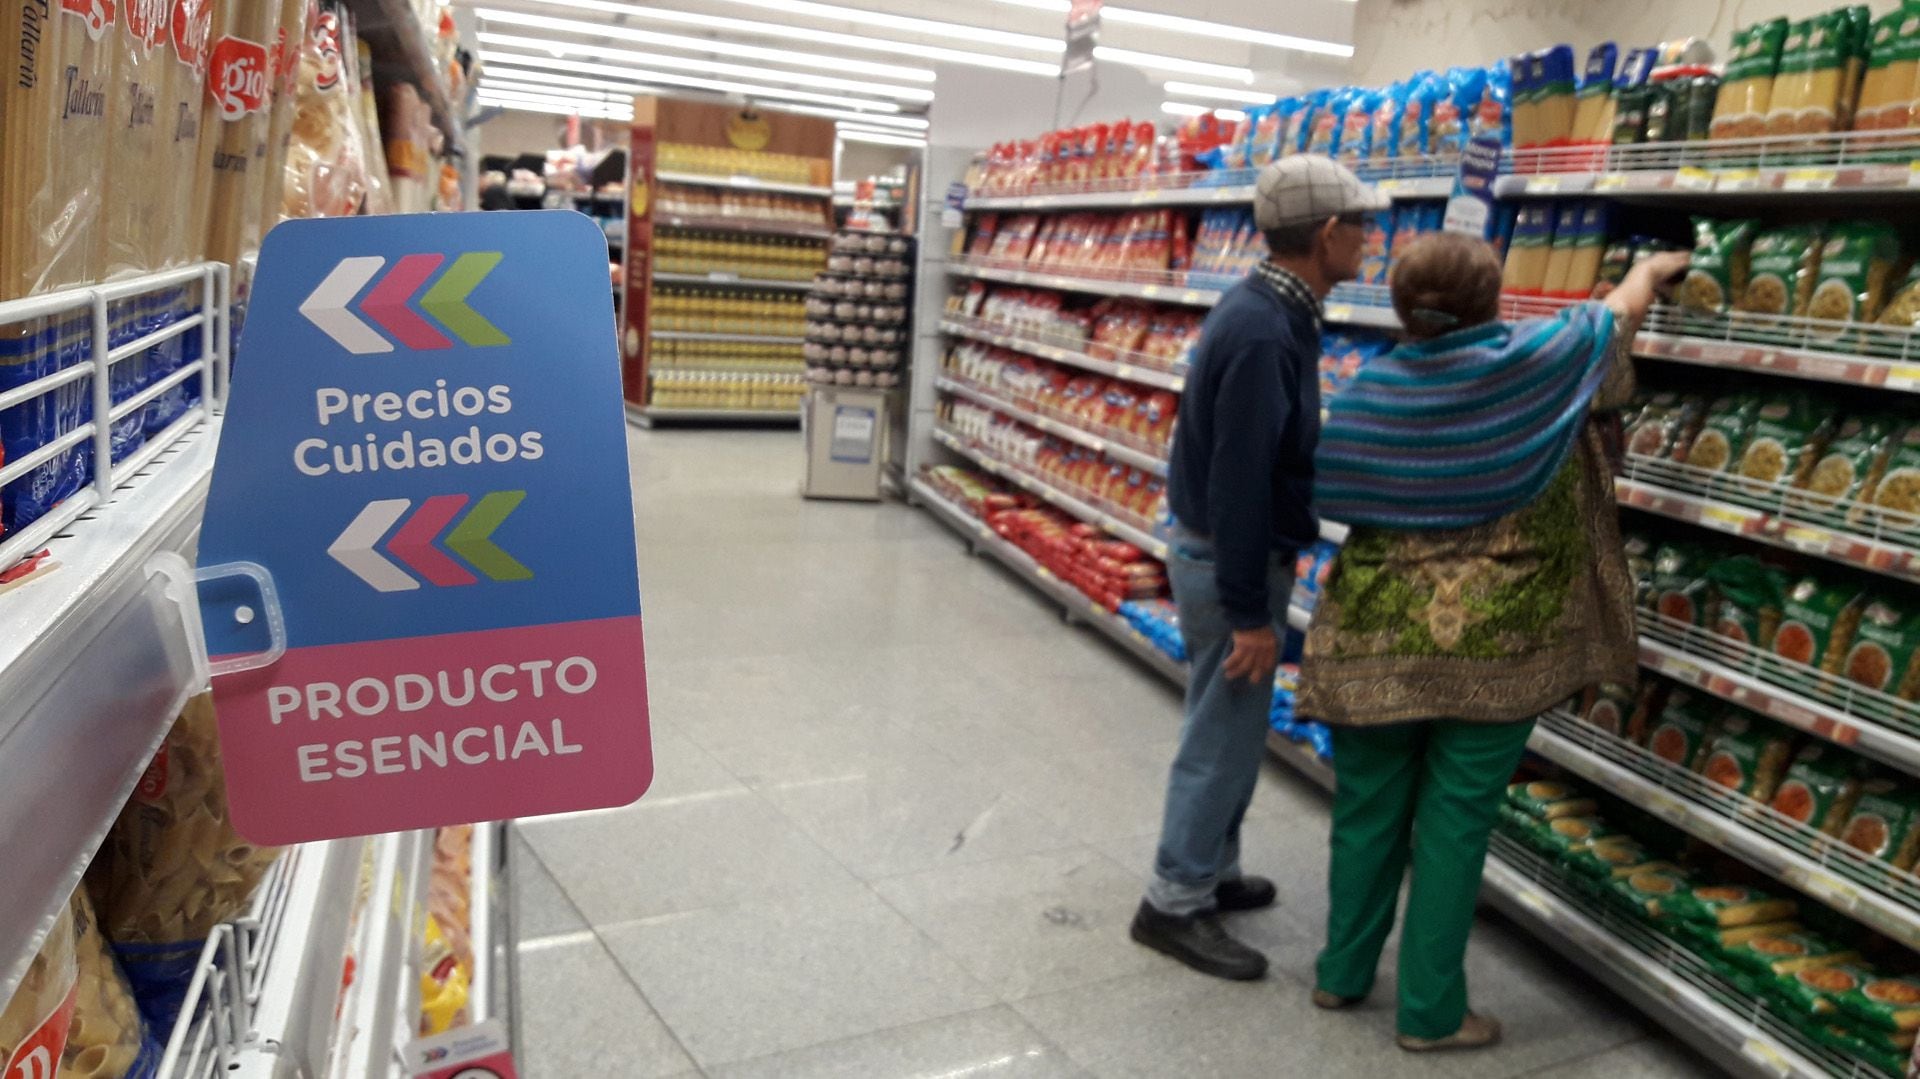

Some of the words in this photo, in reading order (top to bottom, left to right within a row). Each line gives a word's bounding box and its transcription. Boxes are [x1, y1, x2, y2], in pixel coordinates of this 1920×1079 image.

[316, 379, 512, 425] Precios
[294, 426, 544, 476] Cuidados
[267, 656, 597, 725] PRODUCTO
[297, 718, 583, 783] ESENCIAL
